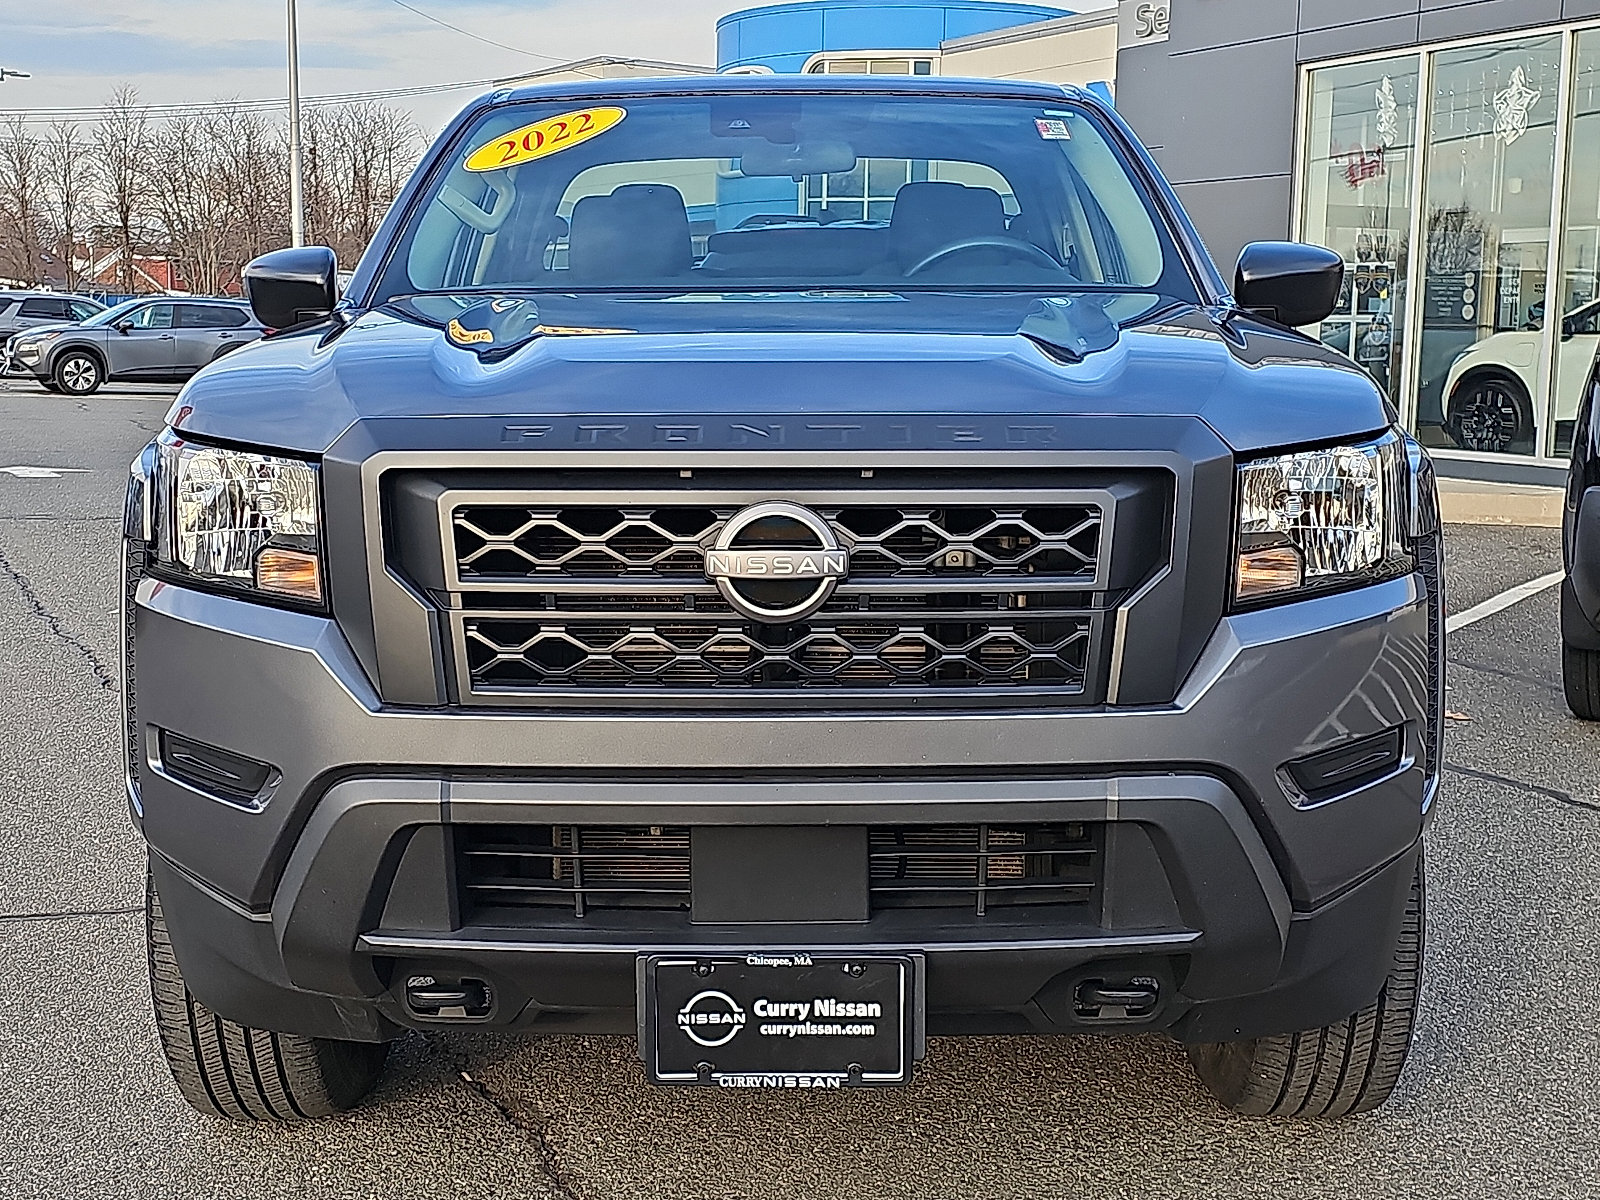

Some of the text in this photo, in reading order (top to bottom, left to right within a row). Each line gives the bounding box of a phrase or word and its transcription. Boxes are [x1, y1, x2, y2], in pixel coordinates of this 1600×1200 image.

[496, 113, 595, 163] 2022
[500, 423, 1057, 444] FRONTIER
[708, 555, 845, 574] NISSAN
[793, 956, 813, 966] MA
[677, 1013, 746, 1025] NISSAN
[753, 999, 882, 1021] Curry Nissan
[759, 1021, 876, 1038] currynissan.com
